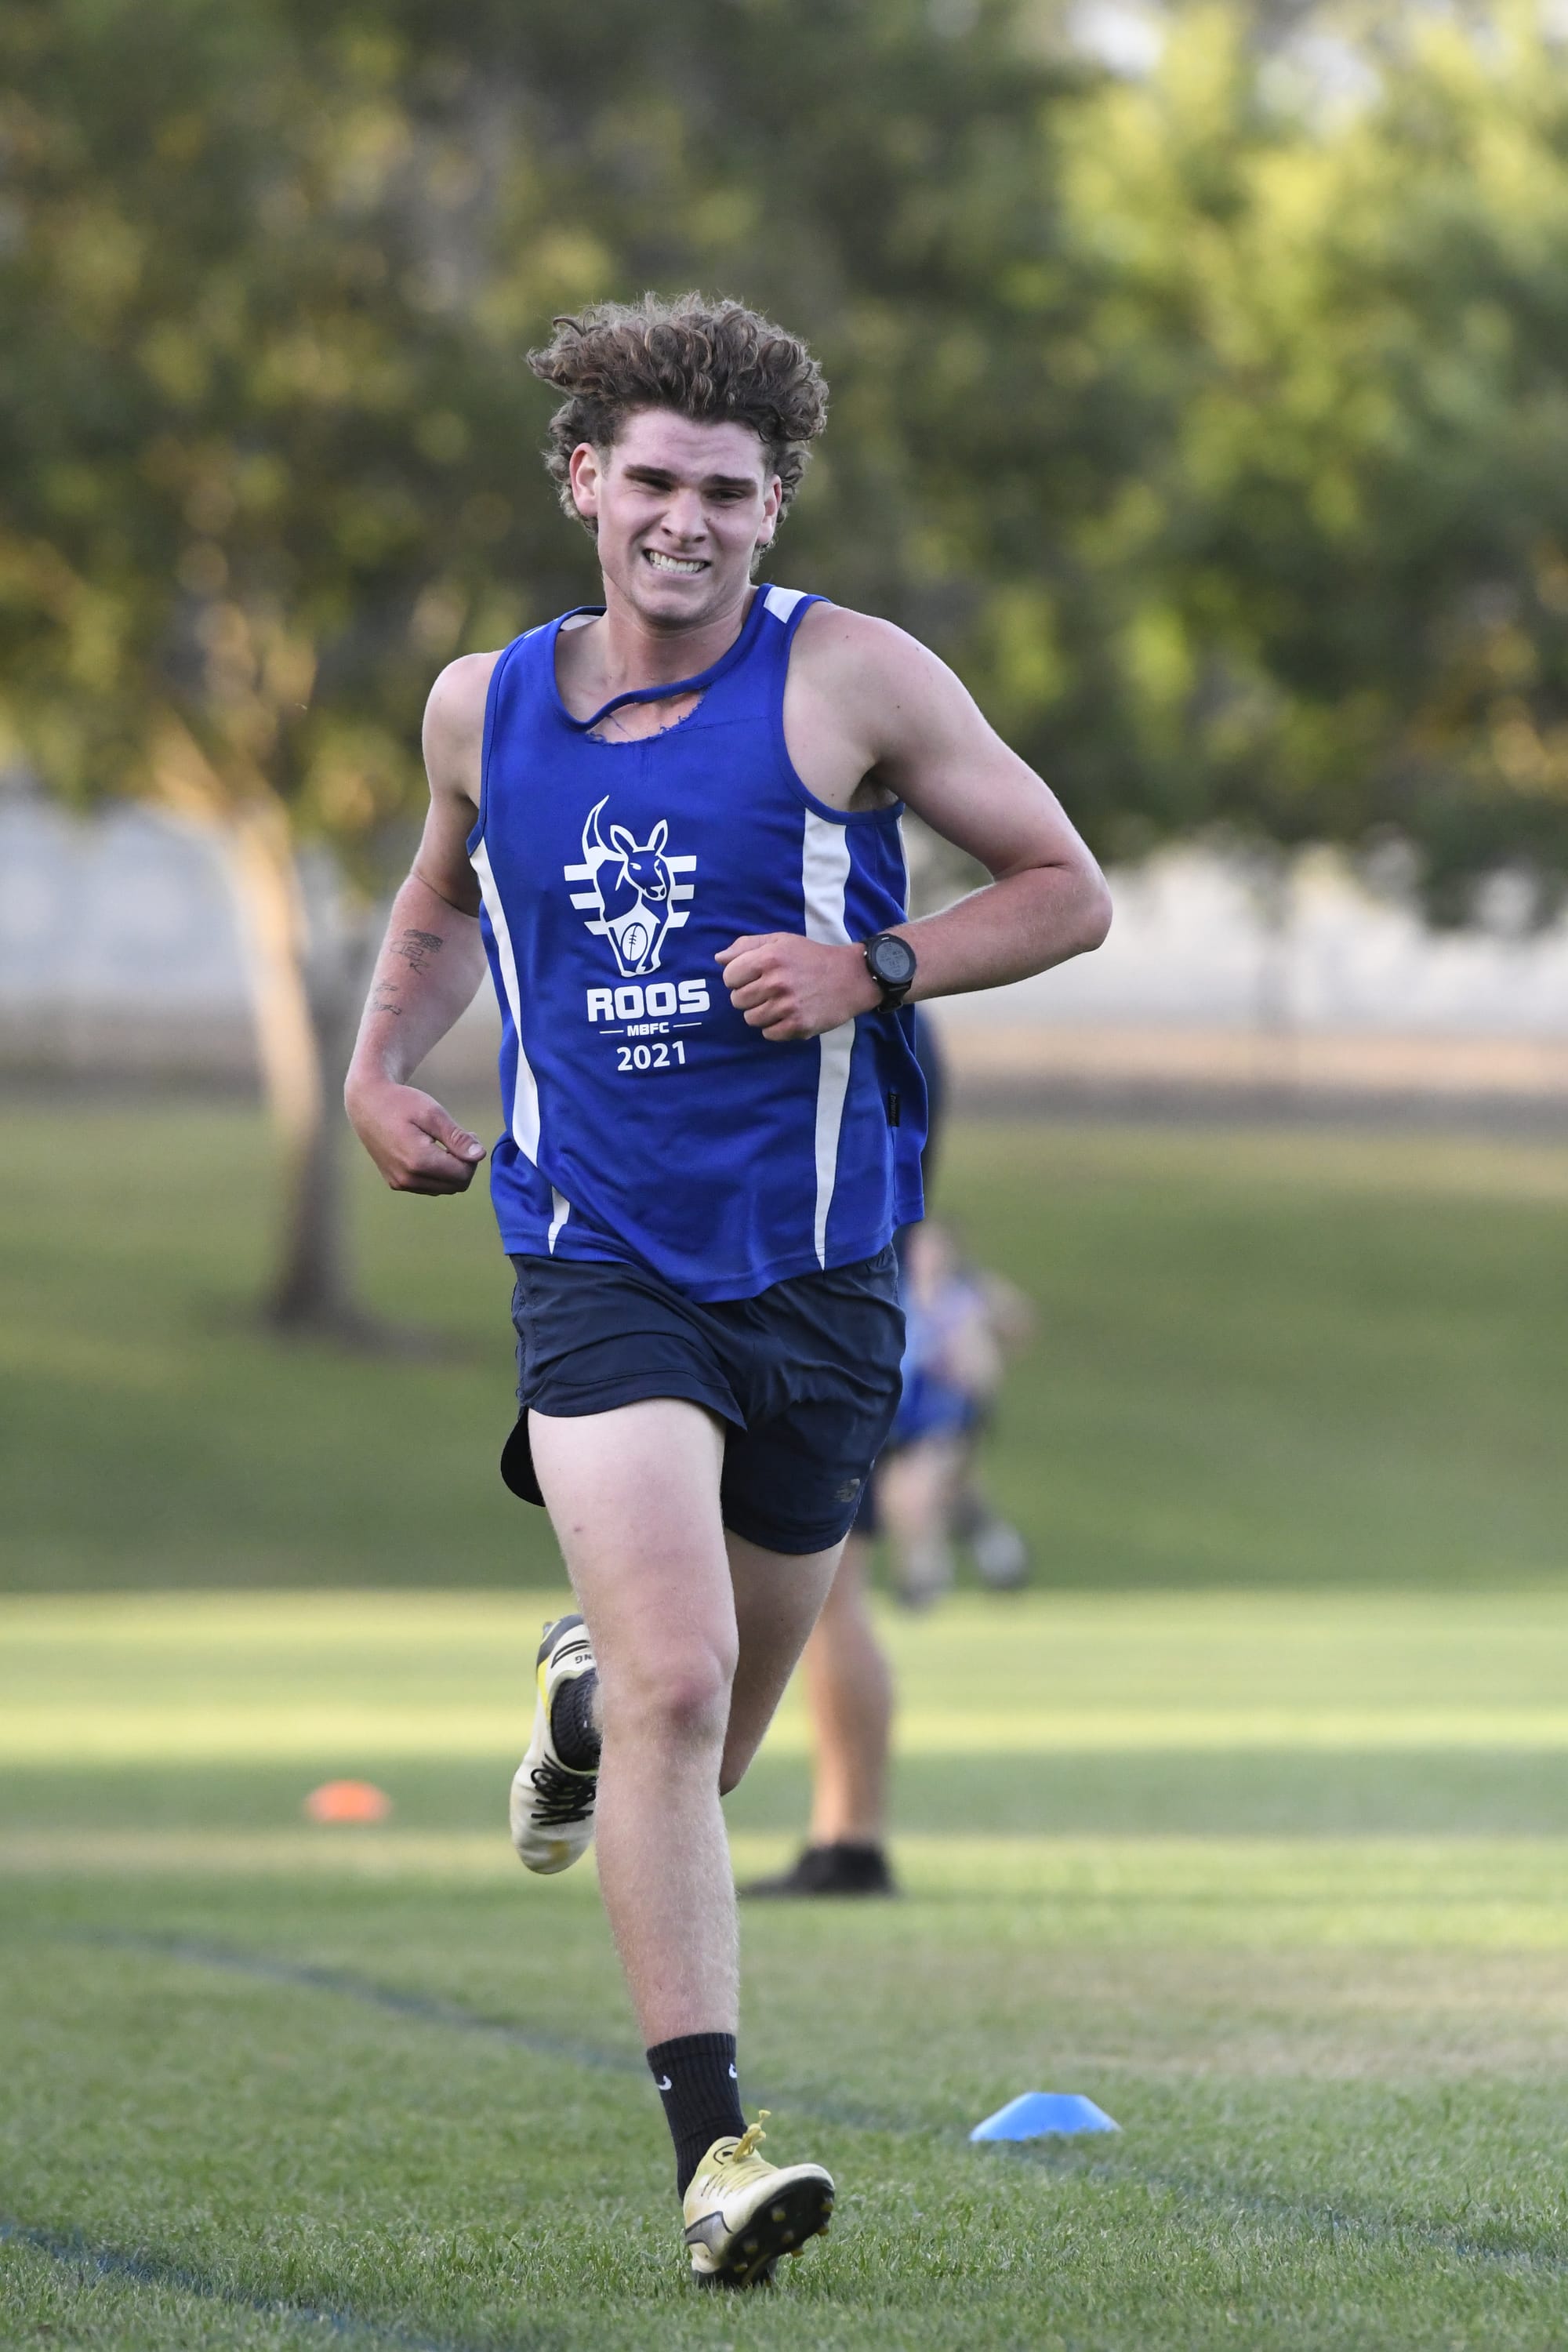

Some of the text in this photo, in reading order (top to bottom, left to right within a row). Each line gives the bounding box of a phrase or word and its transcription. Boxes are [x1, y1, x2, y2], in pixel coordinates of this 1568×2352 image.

[586, 978, 710, 1022] ROOS
[627, 1022, 670, 1036] MBFC
[616, 1040, 686, 1071] 2021
[575, 1653, 592, 1664] NG
